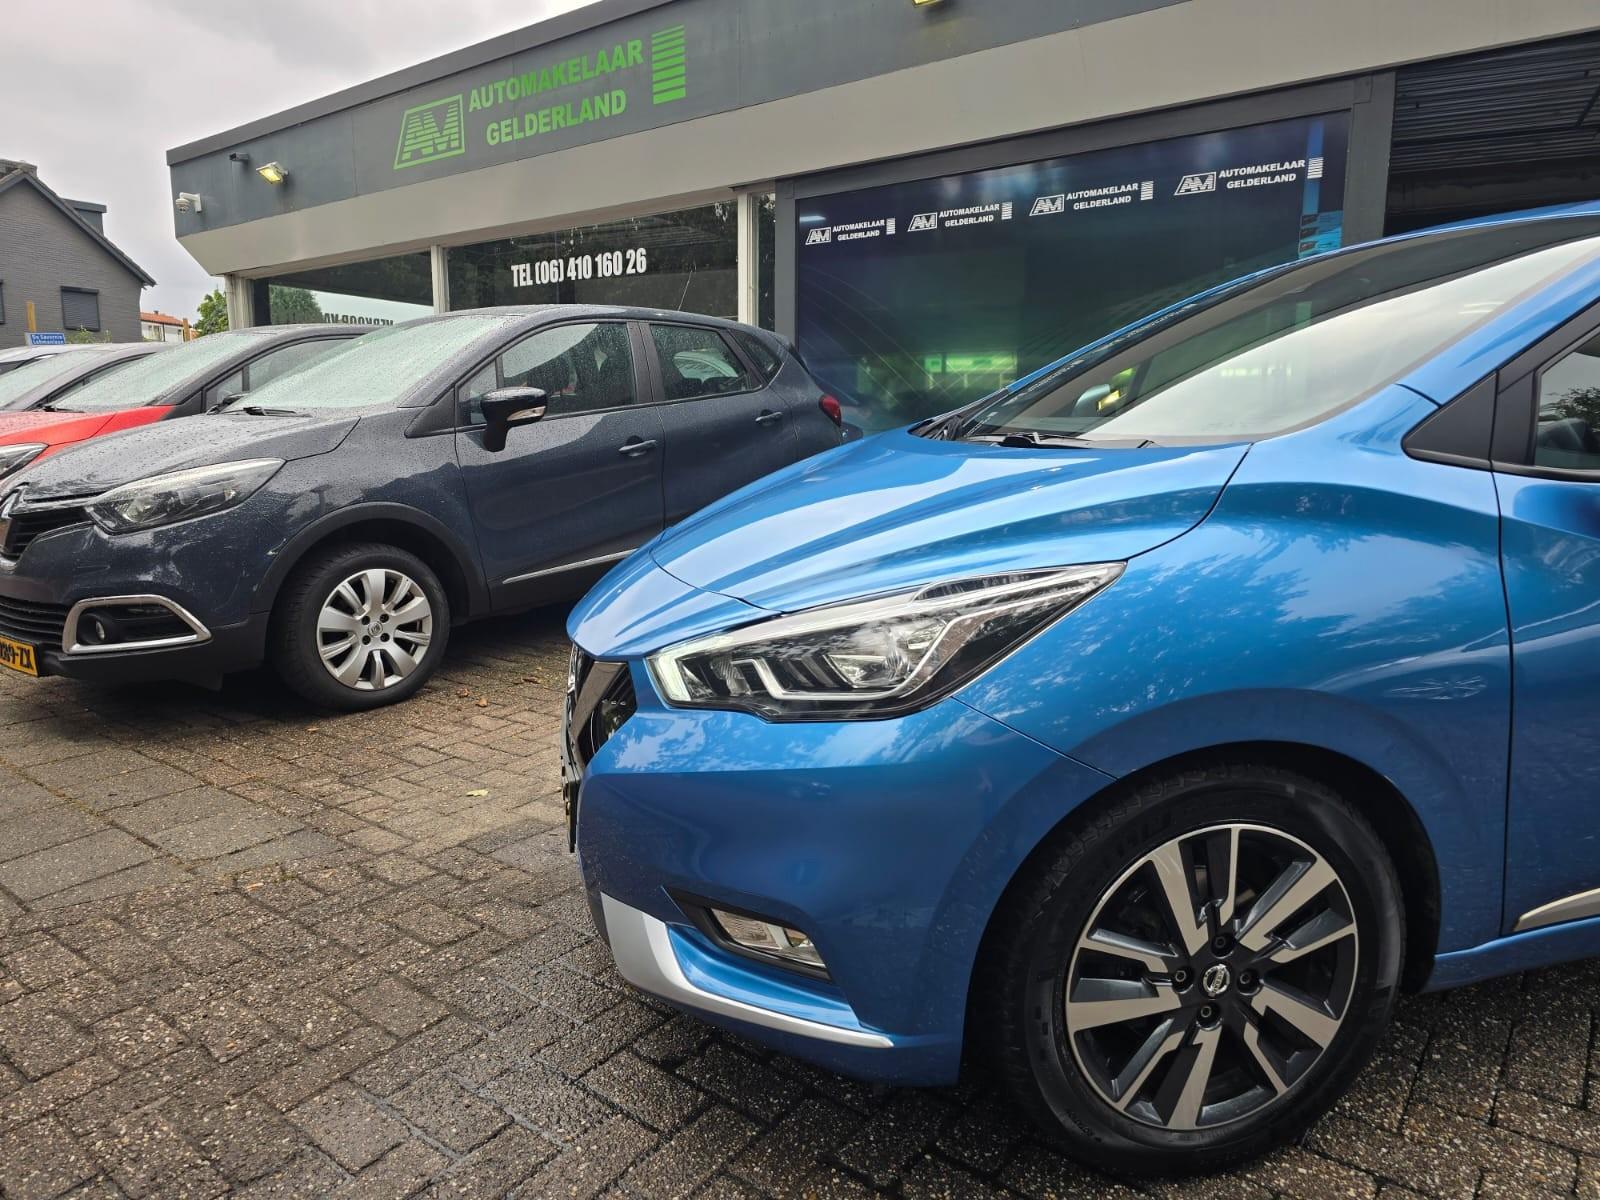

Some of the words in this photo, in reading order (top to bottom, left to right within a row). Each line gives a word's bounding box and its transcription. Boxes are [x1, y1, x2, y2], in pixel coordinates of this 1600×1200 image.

[468, 39, 645, 113] AUTOMAKELAAR
[486, 89, 627, 146] GELDERLAND
[400, 101, 461, 161] AM
[1218, 158, 1306, 179] AUTOMAKELAAR
[1226, 172, 1297, 189] GELDERLAND
[1066, 182, 1139, 201] AUTOMAKELAAR
[939, 203, 1000, 219] AUTOMAKELAAR
[1073, 195, 1132, 210] GELDERLAND
[832, 219, 885, 233] AUTOMAKELAAR
[945, 214, 994, 227] GELDERLAND
[837, 229, 880, 241] GELDERLAND
[510, 263, 533, 287] TEL
[534, 259, 564, 285] (06)
[566, 254, 592, 281] 410
[595, 250, 623, 278] 160
[625, 247, 647, 275] 26
